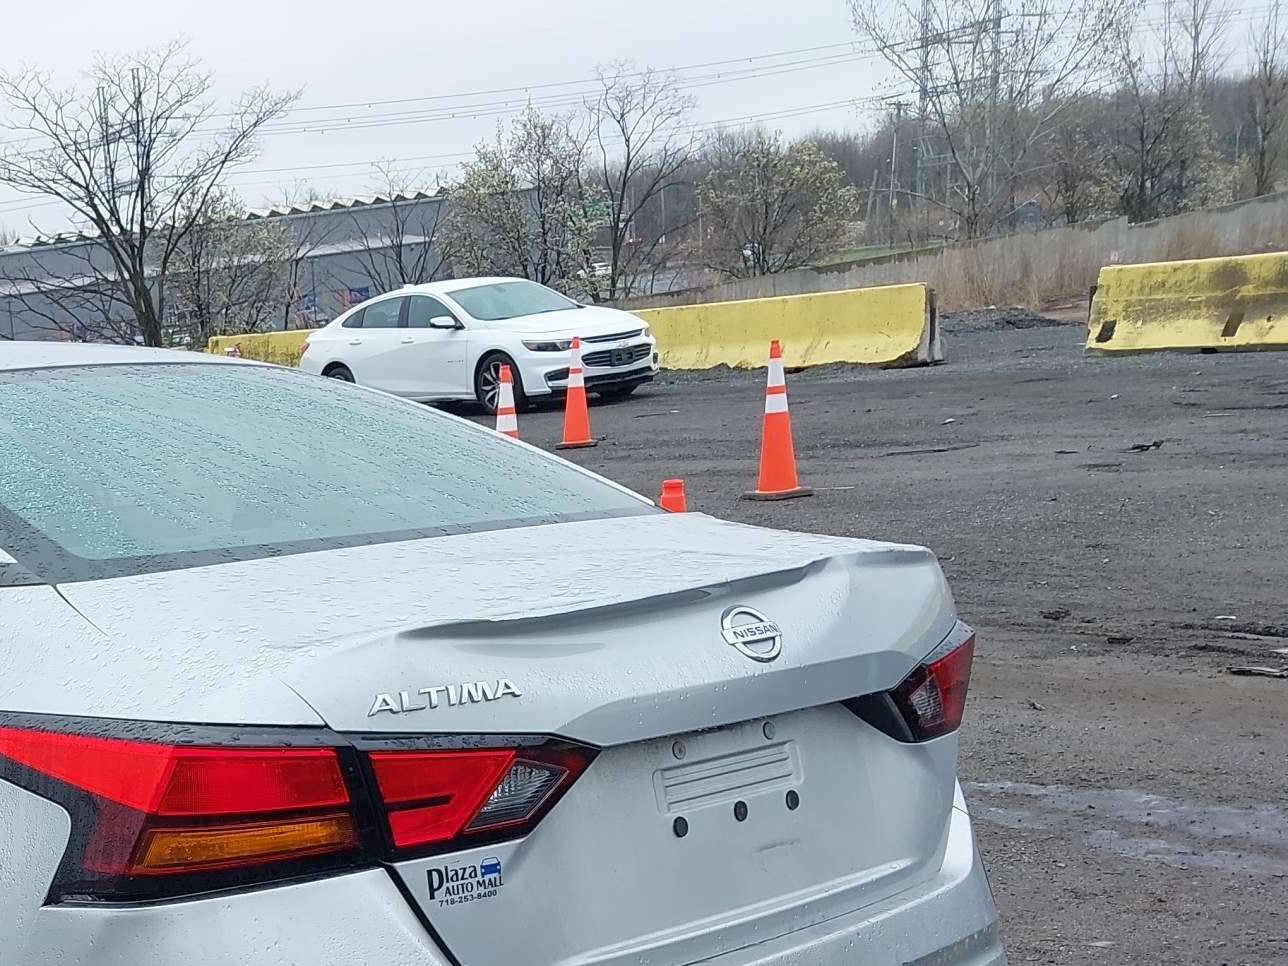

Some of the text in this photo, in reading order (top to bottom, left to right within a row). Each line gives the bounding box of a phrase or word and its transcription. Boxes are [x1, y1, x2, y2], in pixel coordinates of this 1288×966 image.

[732, 624, 779, 639] NISSAN
[367, 678, 522, 717] ALTIMA
[426, 865, 478, 900] Plaza
[444, 876, 504, 898] AUTO MALL
[439, 889, 498, 907] 718-253-8400
